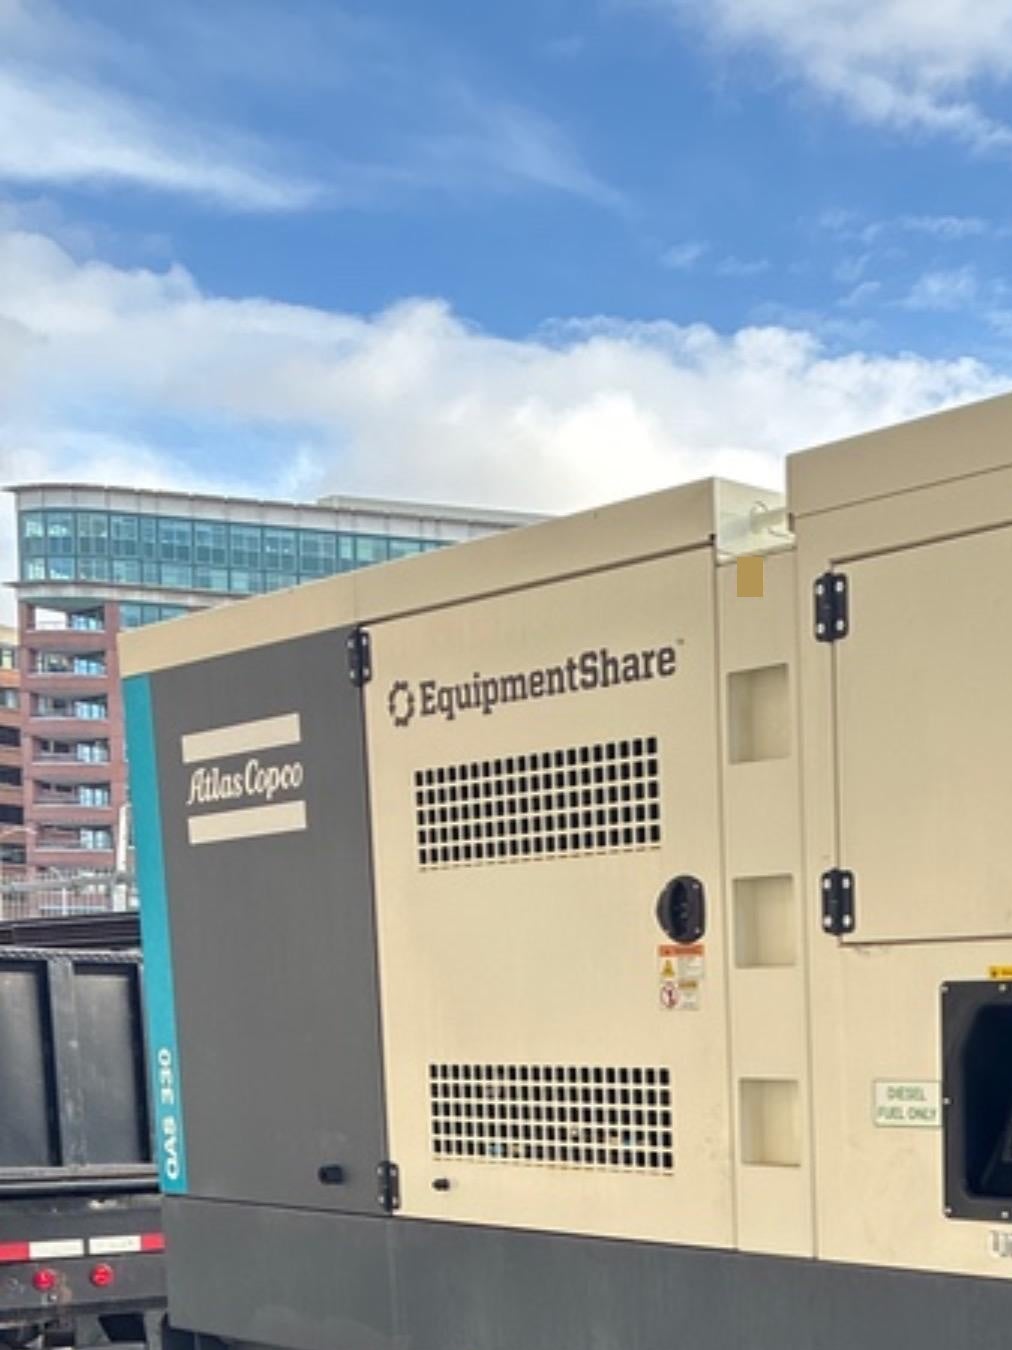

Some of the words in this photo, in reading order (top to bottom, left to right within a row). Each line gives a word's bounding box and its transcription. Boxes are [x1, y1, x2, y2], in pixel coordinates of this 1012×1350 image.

[419, 645, 677, 721] EquipmentShare
[185, 766, 244, 806] Atlas
[244, 758, 304, 801] Copco
